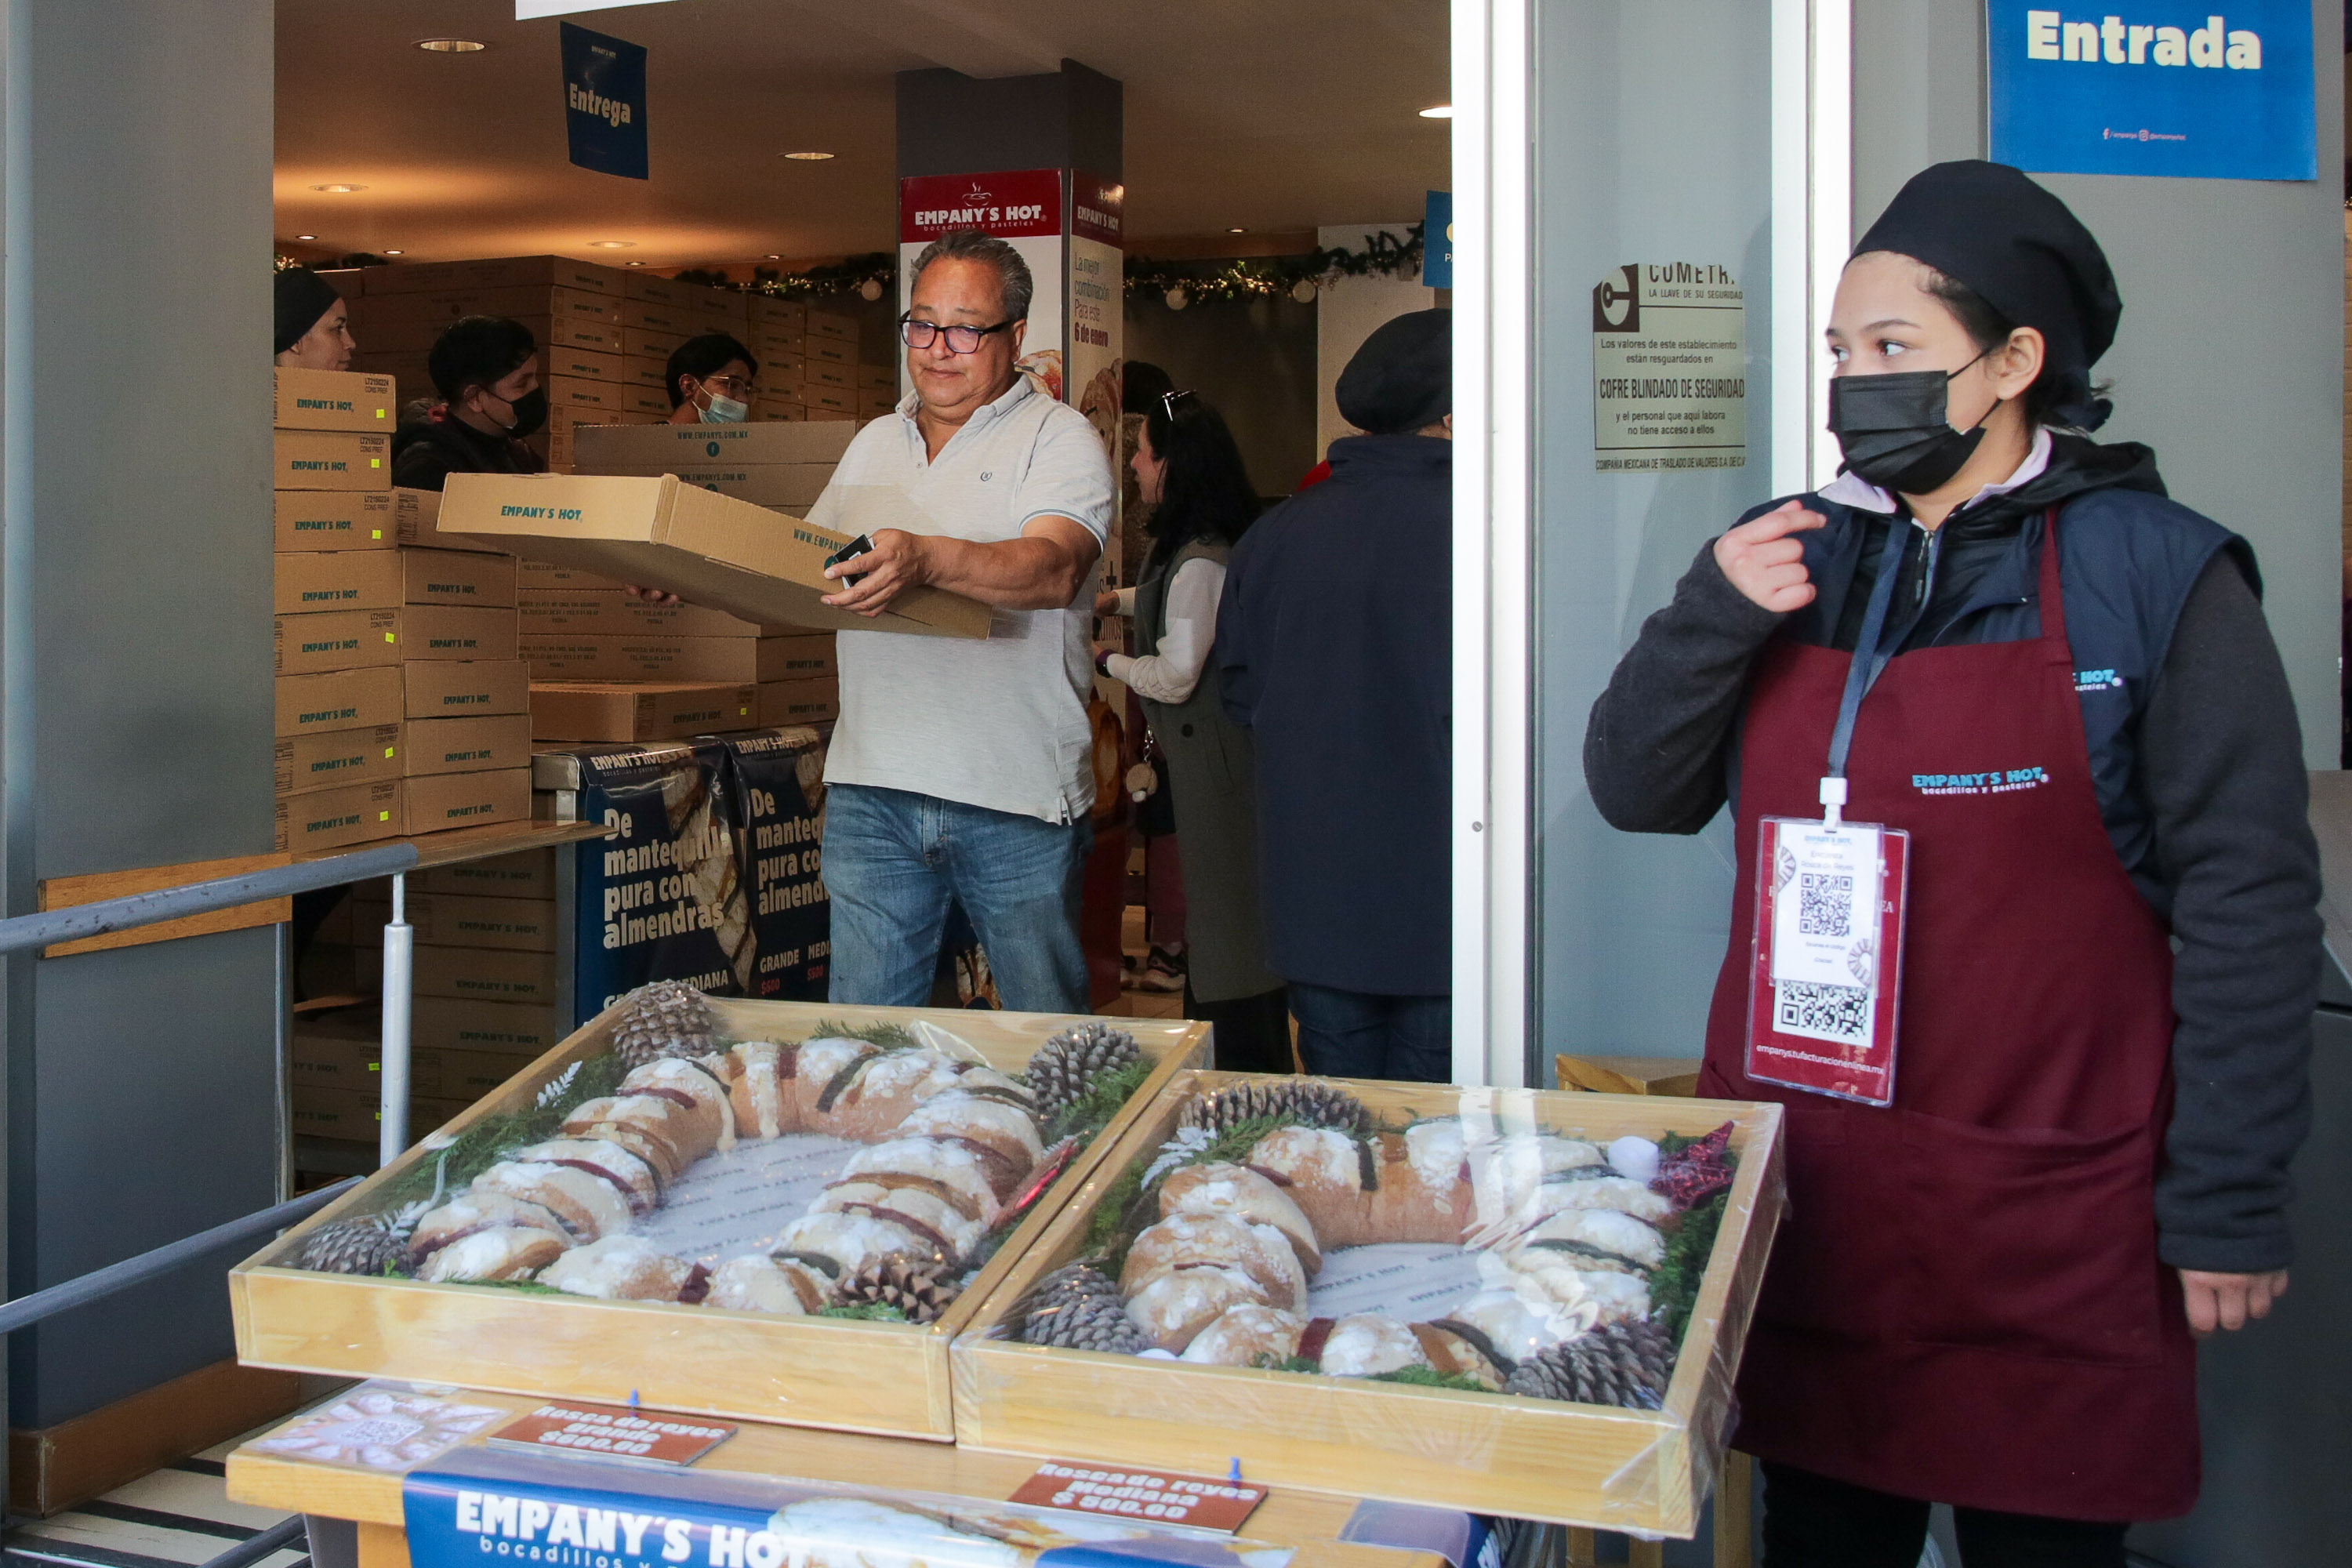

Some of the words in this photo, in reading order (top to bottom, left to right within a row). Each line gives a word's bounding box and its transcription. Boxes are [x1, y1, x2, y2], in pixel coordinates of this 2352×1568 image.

[2027, 10, 2262, 70] Entrada
[569, 82, 631, 127] Entrega
[915, 207, 1000, 226] EMPANY'S
[1006, 205, 1042, 220] HOT
[991, 220, 1033, 229] pasteles
[1077, 205, 1107, 227] EMPANY'S
[1661, 289, 1679, 298] LLAVE
[1708, 290, 1743, 299] SEGURIDAD
[1075, 299, 1088, 320] Para
[1074, 321, 1080, 342] 6
[1081, 323, 1089, 343] de
[1091, 328, 1108, 347] enero
[1601, 339, 1616, 348] Los
[1617, 339, 1646, 349] valores
[1649, 339, 1657, 349] de
[1660, 339, 1676, 349] este
[1678, 339, 1737, 350] establecimiento
[1626, 354, 1647, 363] están
[1650, 354, 1702, 365] resguardados
[1599, 379, 1628, 398] COFRE
[1632, 379, 1678, 398] BLINDADO
[1682, 379, 1692, 398] DE
[1694, 379, 1744, 398] SEGURIDAD
[296, 398, 334, 410] EMPANY'S
[336, 401, 353, 411] HOT
[1616, 413, 1621, 423] y
[1622, 412, 1630, 420] el
[1632, 410, 1665, 423] personal
[1668, 412, 1682, 423] que
[1701, 410, 1726, 420] labora
[1639, 425, 1659, 434] tiene
[1661, 426, 1688, 434] acceso
[1697, 424, 1715, 434] ellos
[291, 461, 328, 470] EMPANY'S
[331, 462, 347, 471] HOT
[501, 506, 554, 518] EMPANY'S
[558, 509, 582, 521] HOT
[295, 521, 333, 530] EMPANY'S
[336, 521, 351, 530] HOT
[302, 590, 339, 601] EMPANY'S
[343, 590, 358, 598] HOT
[302, 641, 339, 652] EMPANY'S
[343, 640, 358, 649] HOT
[2080, 669, 2115, 684] HOT
[299, 711, 338, 723] EMPANY'S
[341, 708, 356, 718] HOT
[311, 759, 347, 771] EMPANY'S
[349, 756, 364, 766] HOT
[590, 751, 641, 770] EMPANY'S
[1912, 772, 2002, 787] EMPANY'S
[2006, 767, 2042, 782] HOT
[1922, 786, 1978, 795] bocadillos
[750, 788, 775, 817] De
[307, 818, 343, 832] EMPANY'S
[345, 815, 360, 825] HOT
[604, 808, 633, 840] De
[757, 853, 798, 891] pura
[604, 880, 655, 921] pura
[659, 873, 696, 901] con
[603, 902, 724, 949] almendras
[760, 949, 800, 973] GRANDE
[808, 940, 831, 960] MEDI
[532, 1405, 614, 1425] Rosca
[538, 1430, 652, 1455] $600.00
[1066, 1480, 1200, 1507] Mediana
[1170, 1479, 1258, 1501] reyes
[456, 1490, 693, 1566] EMPANY'S
[709, 1524, 812, 1568] HOT
[480, 1535, 631, 1568] bocadillos
